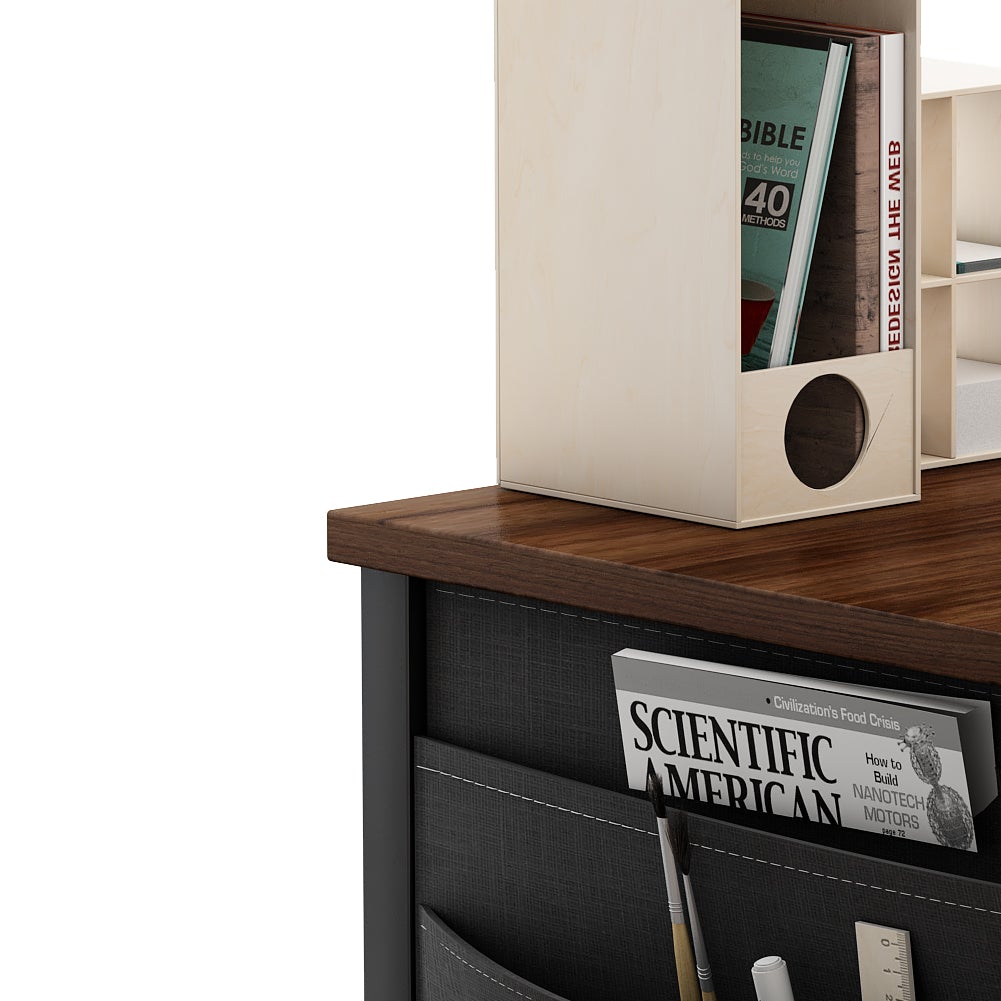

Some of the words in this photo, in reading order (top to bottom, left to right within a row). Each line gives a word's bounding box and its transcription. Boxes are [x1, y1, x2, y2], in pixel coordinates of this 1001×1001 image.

[741, 118, 806, 151] BIBLE
[754, 153, 761, 161] to
[764, 154, 782, 164] help
[771, 166, 799, 179] Word
[744, 181, 790, 217] 40
[742, 213, 786, 228] METHODS
[773, 695, 838, 719] Civilization's
[840, 707, 867, 725] Food
[869, 713, 900, 731] Crisis
[629, 700, 838, 785] SCIENTIFIC
[865, 752, 888, 768] How
[891, 758, 902, 770] to
[873, 771, 898, 786] Build
[853, 783, 925, 811] NANOTECH
[863, 806, 919, 830] MOTORS
[898, 829, 906, 837] 72
[885, 994, 893, 1001] 2
